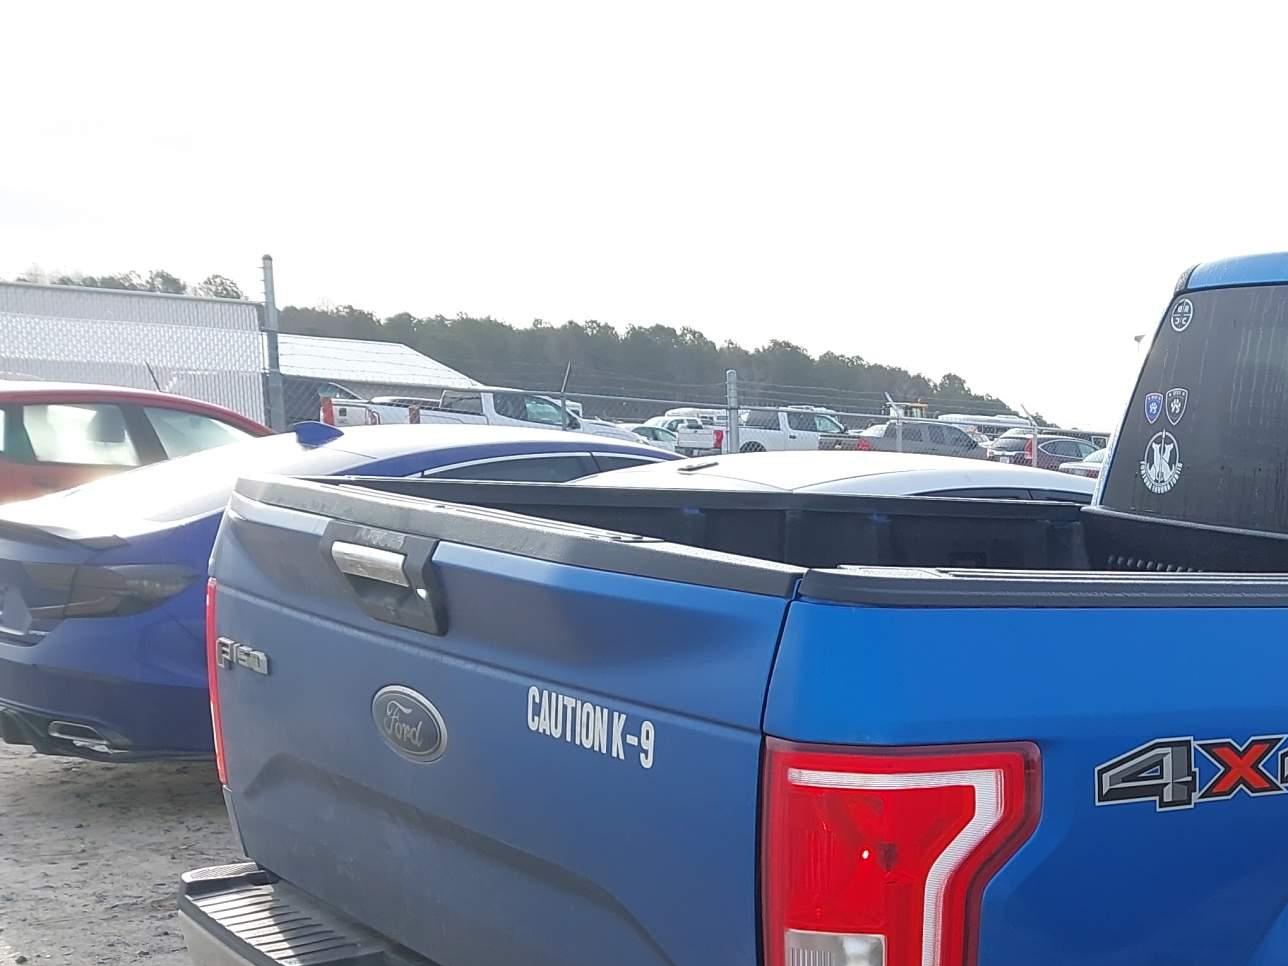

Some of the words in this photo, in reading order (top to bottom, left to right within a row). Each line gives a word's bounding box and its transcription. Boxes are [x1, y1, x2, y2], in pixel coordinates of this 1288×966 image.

[384, 700, 423, 747] Ford
[527, 685, 609, 754] CAUTION
[611, 711, 655, 769] K-9
